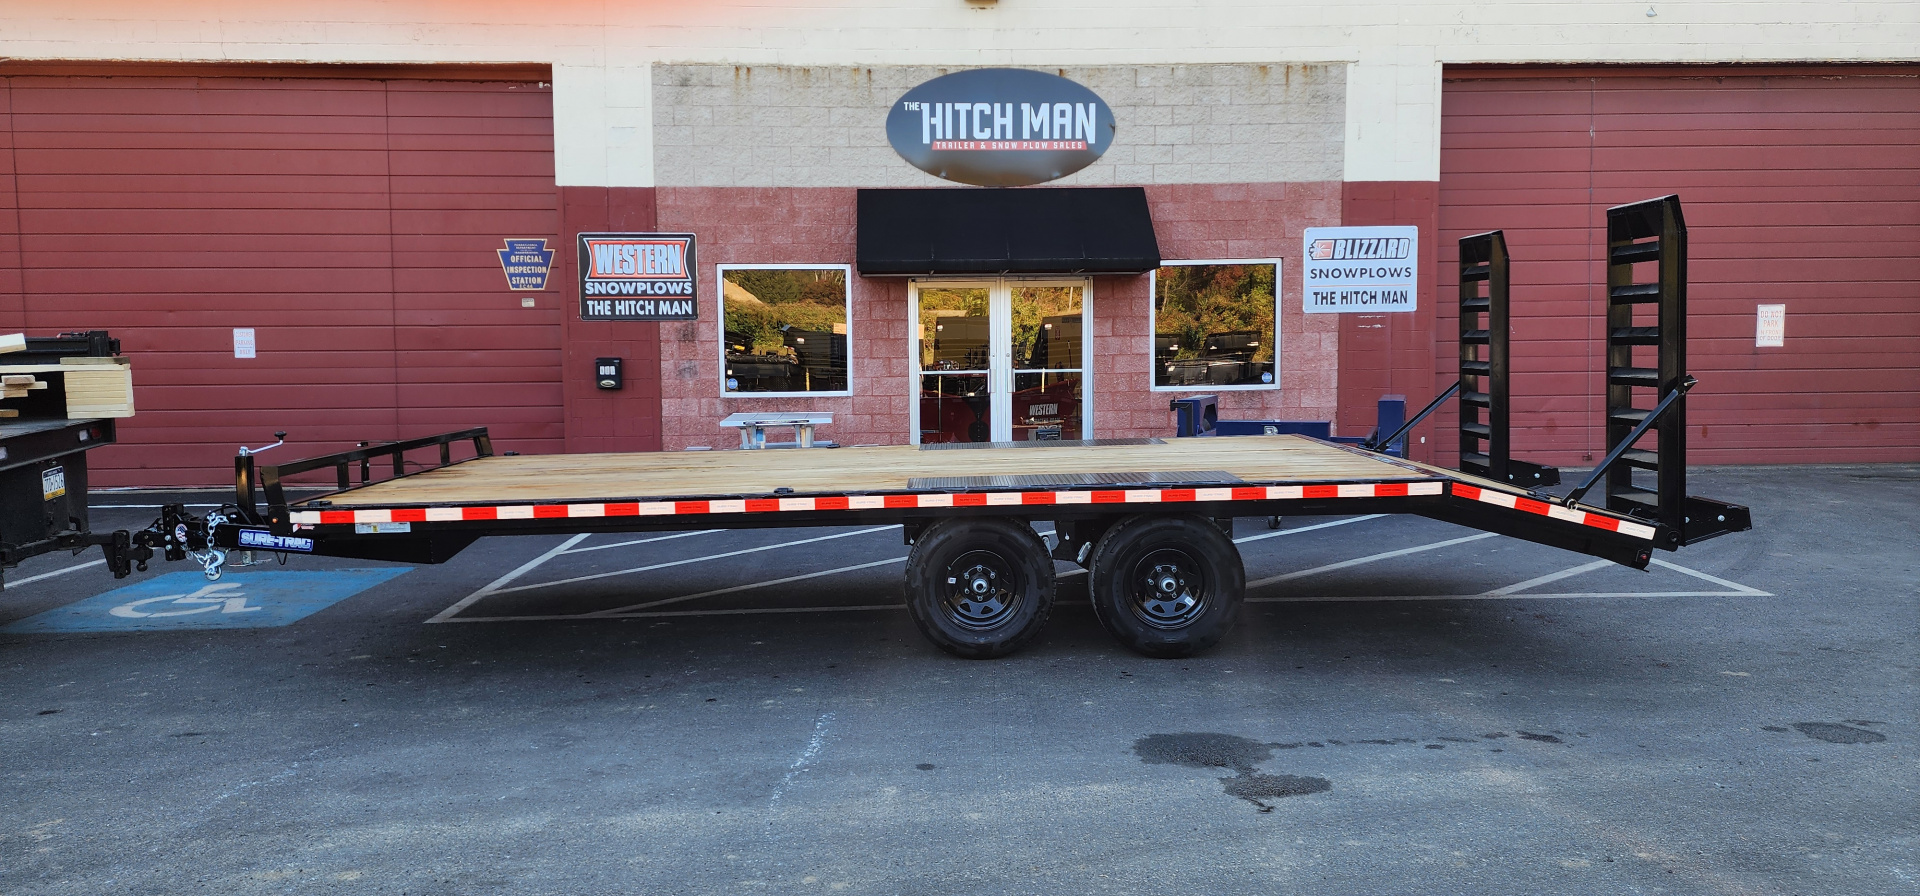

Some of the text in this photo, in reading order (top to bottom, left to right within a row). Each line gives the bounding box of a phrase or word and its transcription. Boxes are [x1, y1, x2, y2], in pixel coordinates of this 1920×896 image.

[903, 102, 1096, 144] THE HITCH MAN
[936, 141, 1082, 149] TRAILER & SNOW PLOW SALES
[1334, 239, 1410, 259] BLIZZARD
[594, 244, 681, 275] WESTERN
[1310, 267, 1412, 279] SNOWPLOWS
[585, 282, 692, 295] SNOWPLOWS
[1313, 291, 1408, 305] THE HITCH MAN
[587, 300, 692, 315] THE HITCH MAN
[1030, 403, 1058, 415] WESTERN
[241, 532, 311, 548] SURE-TRAC
